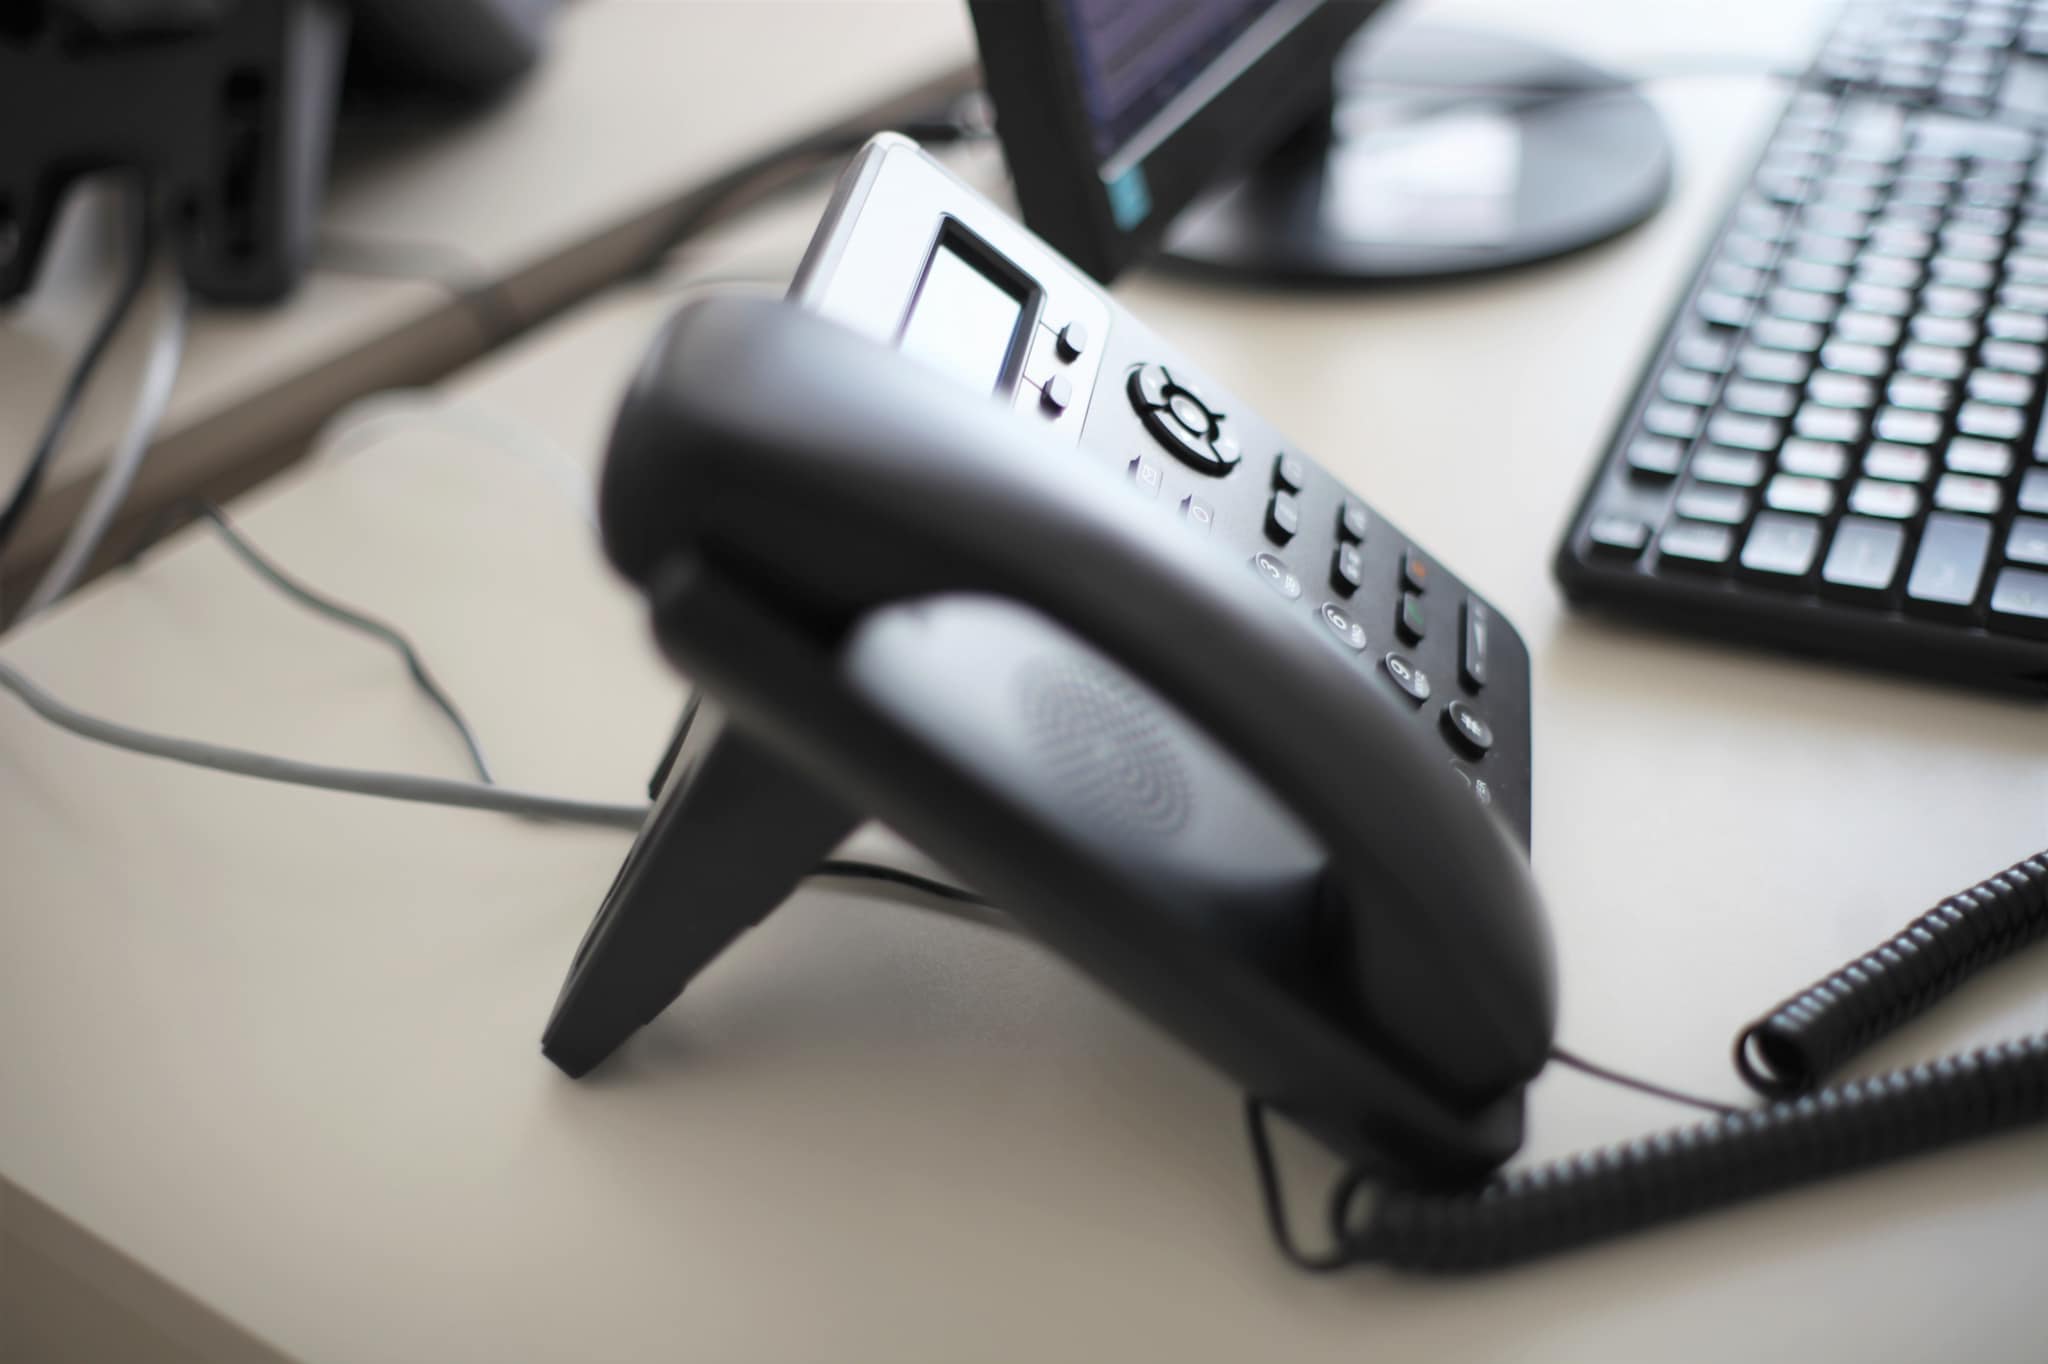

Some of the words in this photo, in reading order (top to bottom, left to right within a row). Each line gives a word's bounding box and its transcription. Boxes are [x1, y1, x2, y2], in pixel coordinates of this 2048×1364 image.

[1260, 558, 1281, 579] 3
[1326, 608, 1347, 631] 6
[1390, 659, 1411, 681] 9
